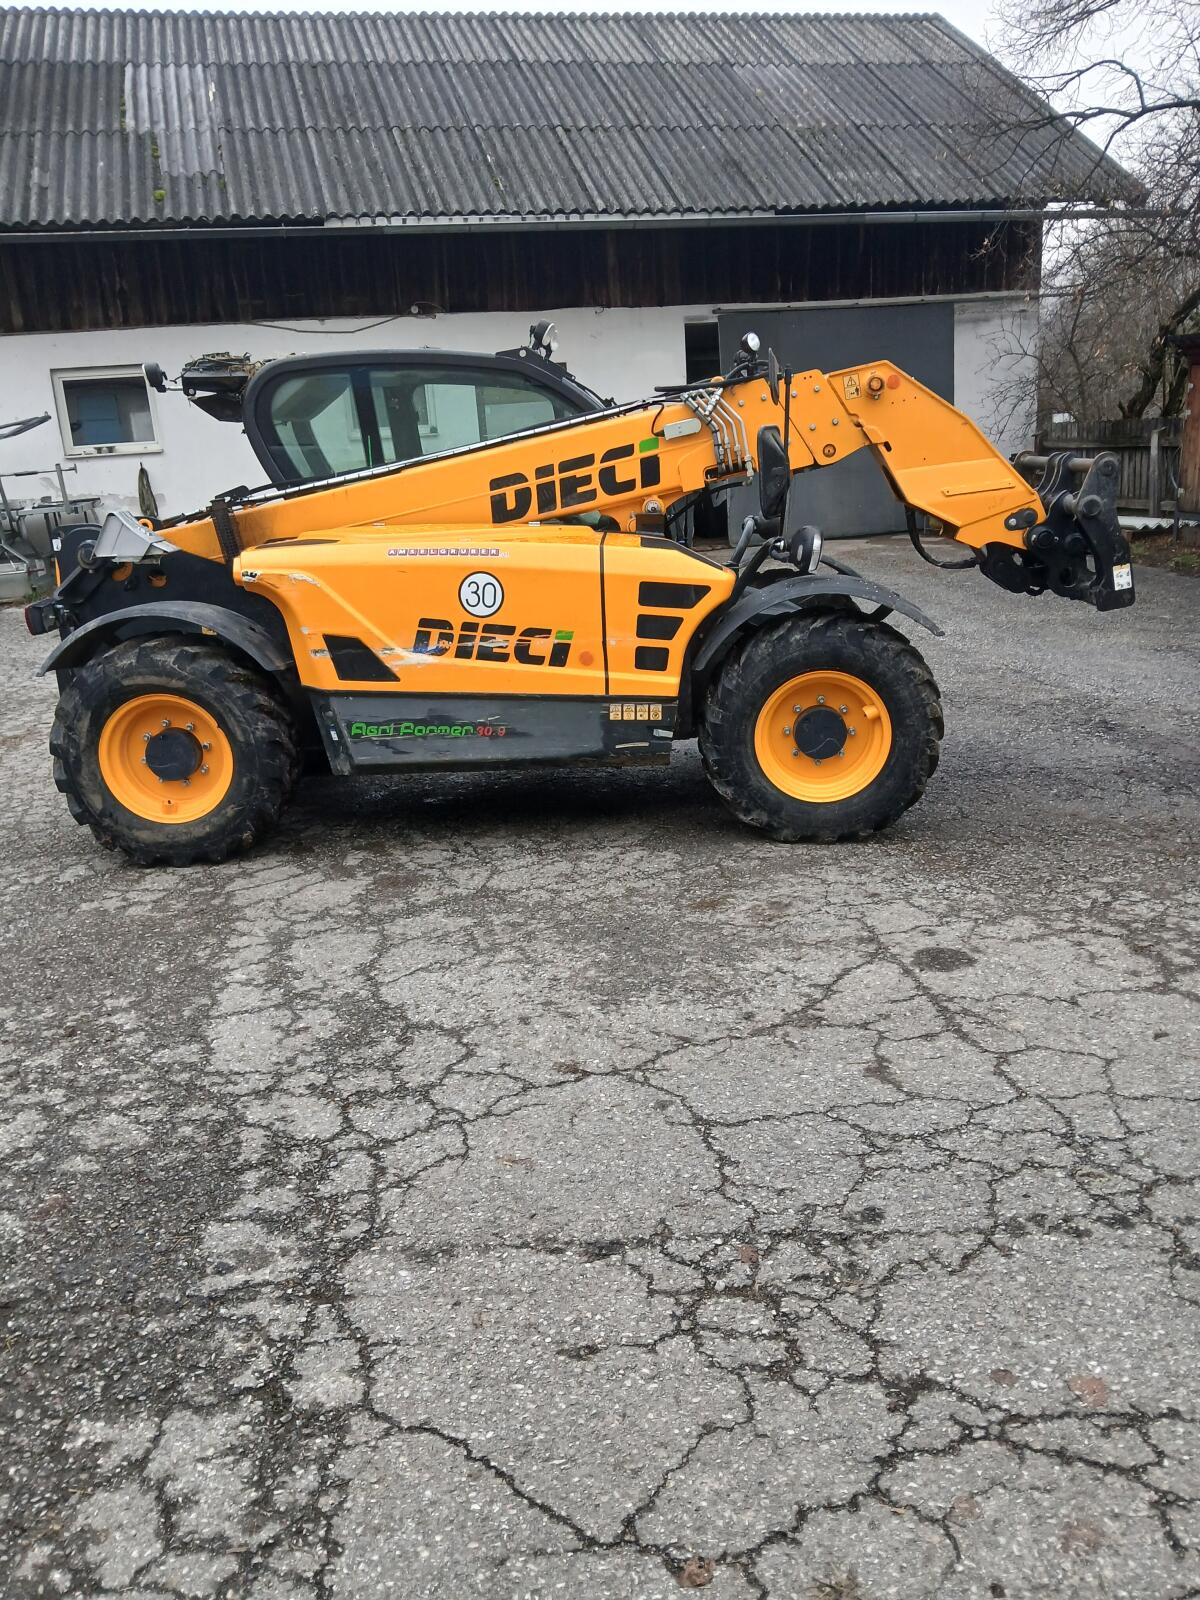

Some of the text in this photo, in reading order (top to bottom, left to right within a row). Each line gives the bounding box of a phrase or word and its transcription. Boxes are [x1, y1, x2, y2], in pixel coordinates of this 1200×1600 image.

[388, 548, 500, 556] AMSELGRUBER
[465, 581, 497, 608] 30
[351, 722, 394, 736] Agri
